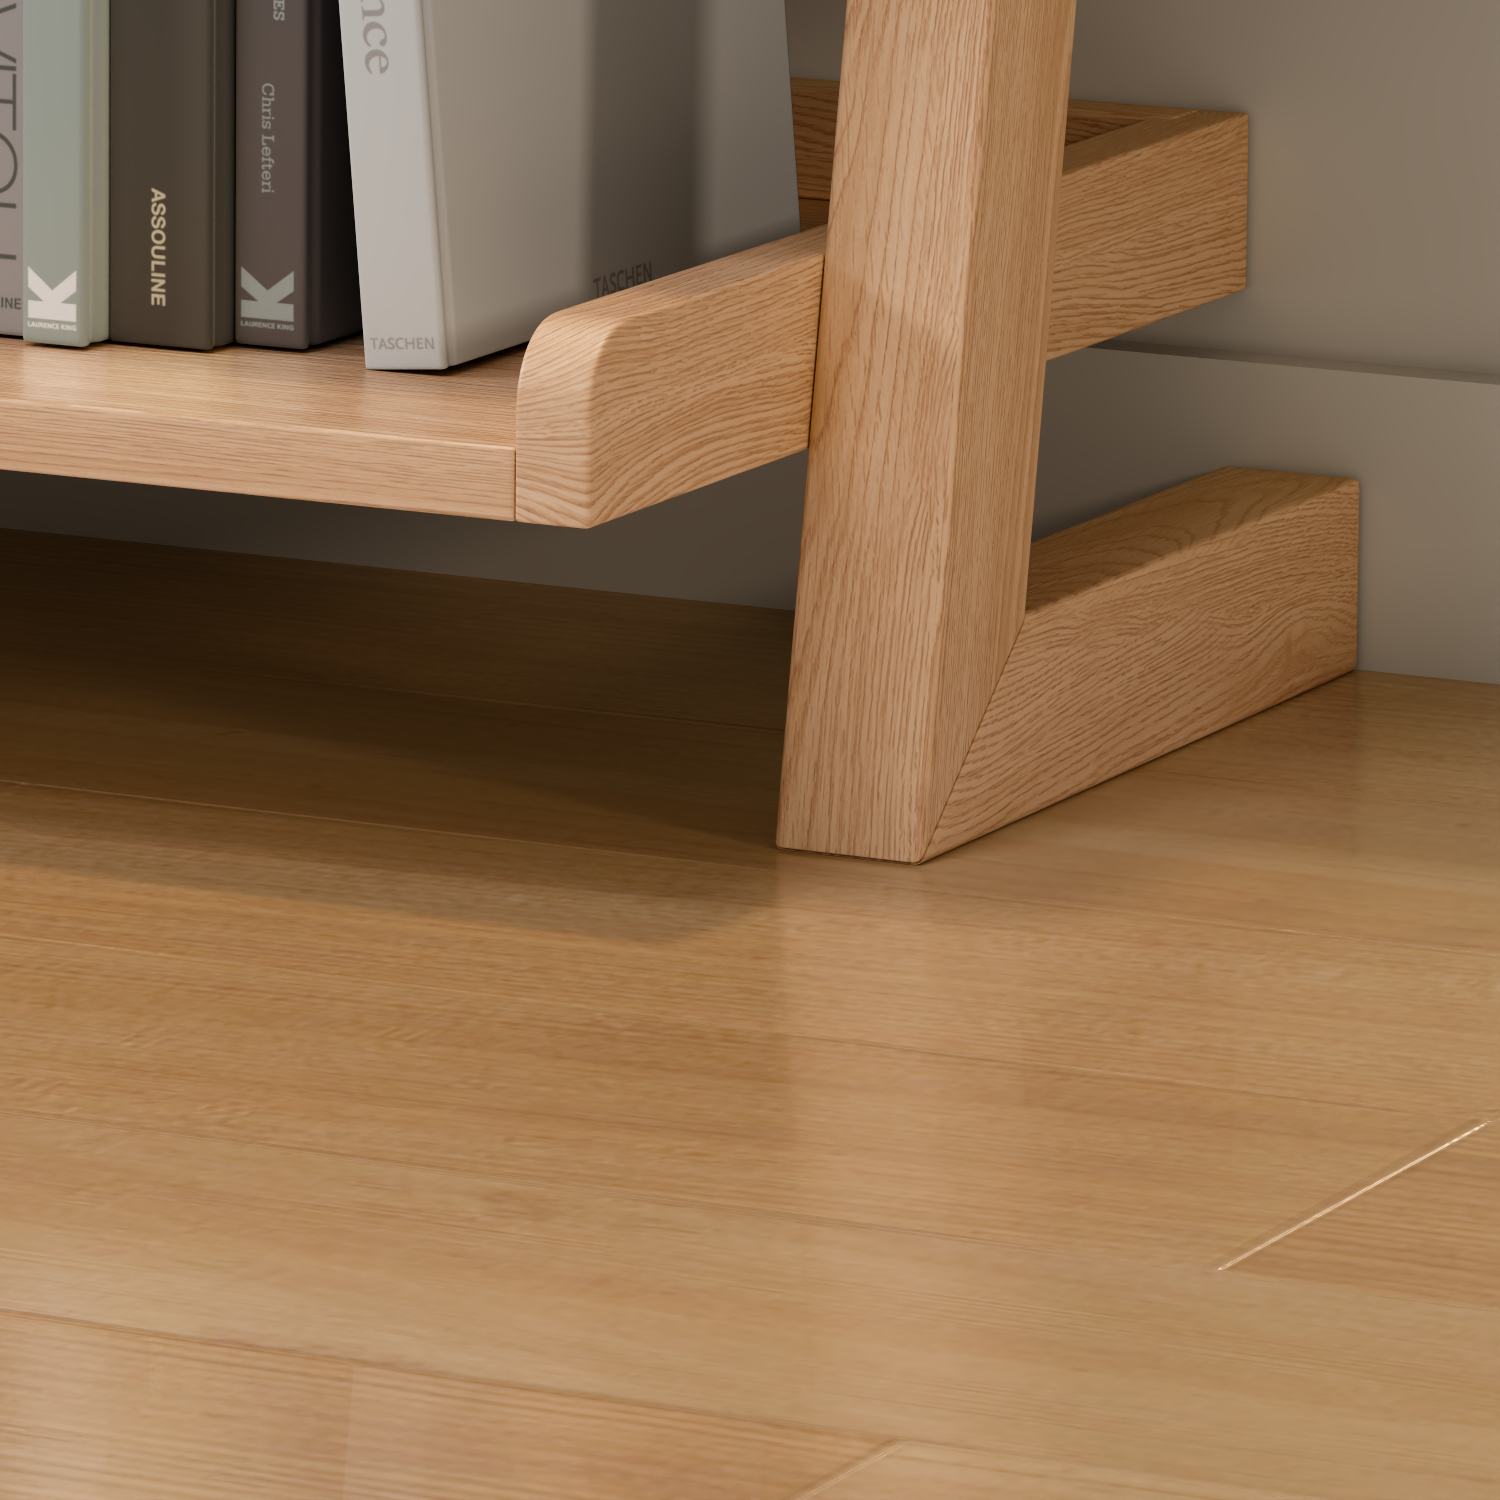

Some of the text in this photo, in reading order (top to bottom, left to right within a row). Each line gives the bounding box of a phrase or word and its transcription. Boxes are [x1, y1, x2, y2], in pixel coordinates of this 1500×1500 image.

[261, 82, 275, 194] Chris Lefteri
[150, 186, 167, 307] ASSOULINE
[593, 260, 653, 298] TASCHEN
[27, 321, 78, 332] LAURENCE KING
[240, 319, 295, 332] LAURENCE KING
[370, 337, 436, 351] TASCHEN
